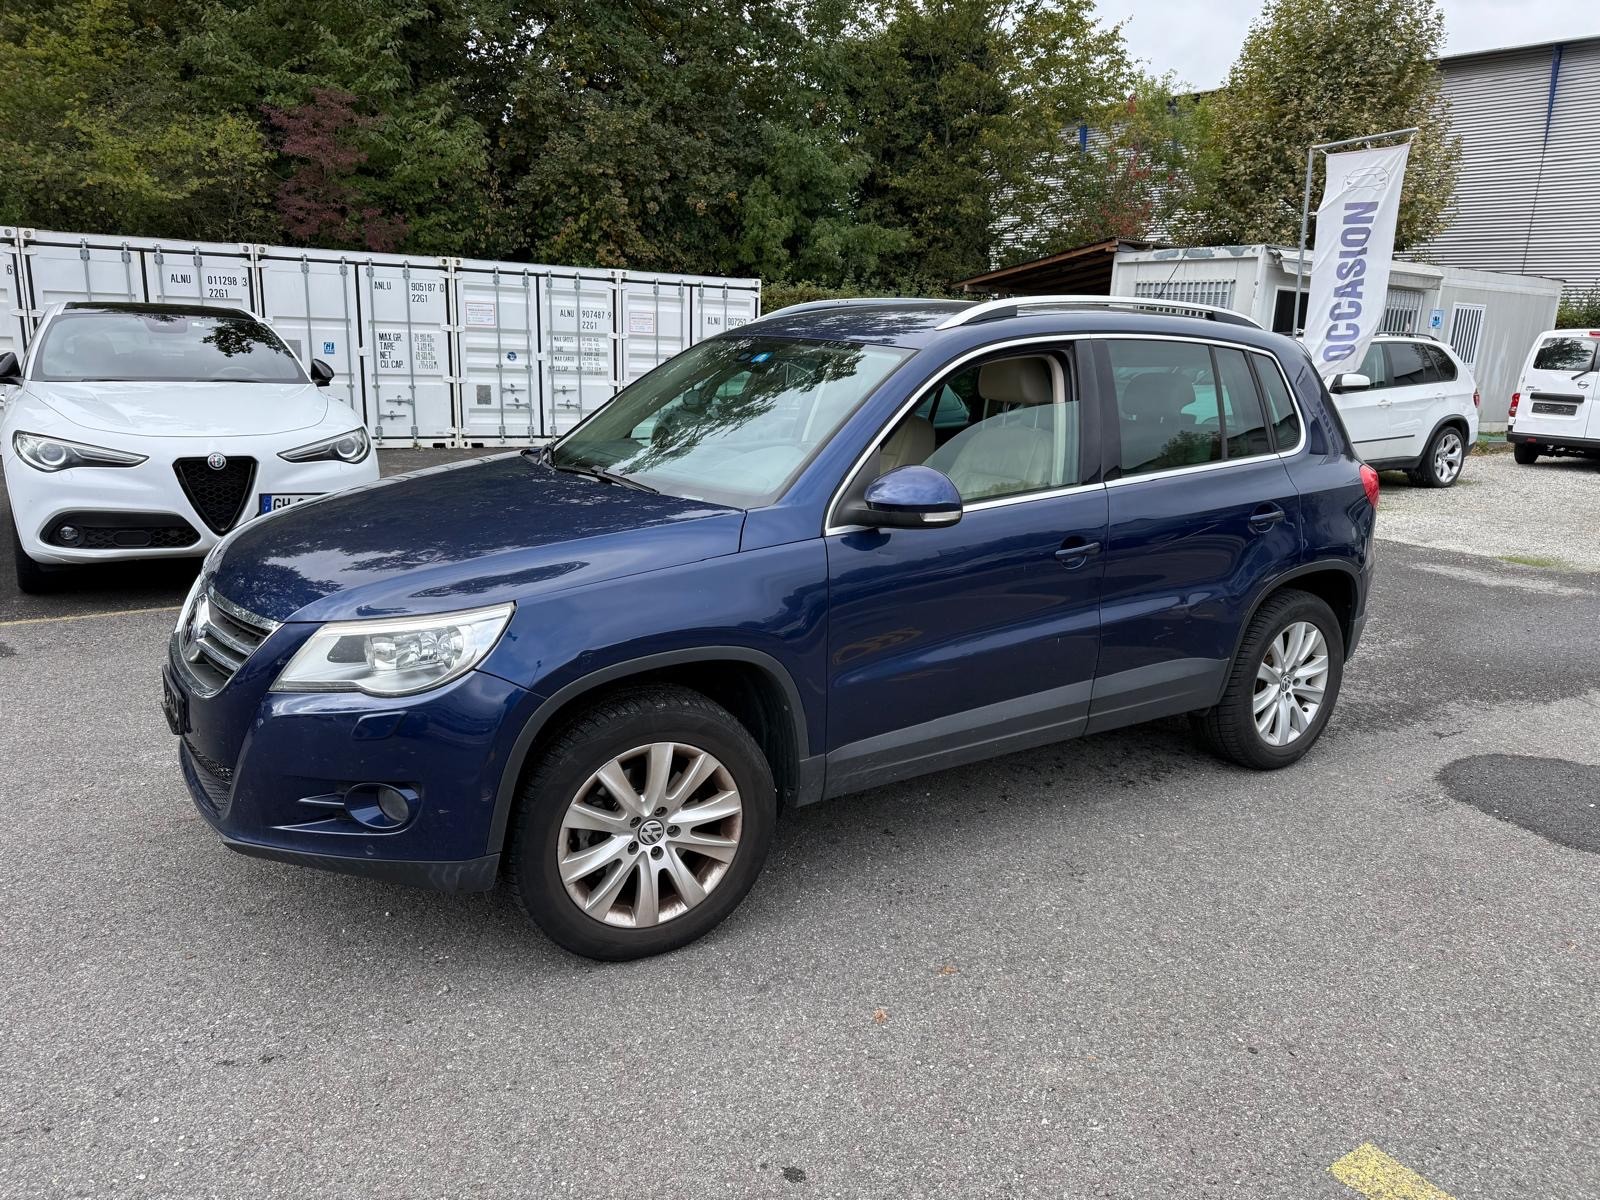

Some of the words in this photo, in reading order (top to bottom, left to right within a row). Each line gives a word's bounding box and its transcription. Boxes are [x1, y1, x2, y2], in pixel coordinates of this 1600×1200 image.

[170, 273, 192, 285] ALNU
[207, 275, 238, 286] 011298
[242, 276, 248, 287] 3
[1322, 200, 1379, 362] OCCASION
[374, 281, 391, 290] ANLU
[411, 282, 435, 292] 905187
[209, 288, 229, 298] 22G1
[411, 294, 427, 303] 22G1
[560, 309, 574, 318] ALNU
[582, 321, 597, 329] 22G1
[380, 342, 395, 350] TARE
[380, 351, 391, 359] NET
